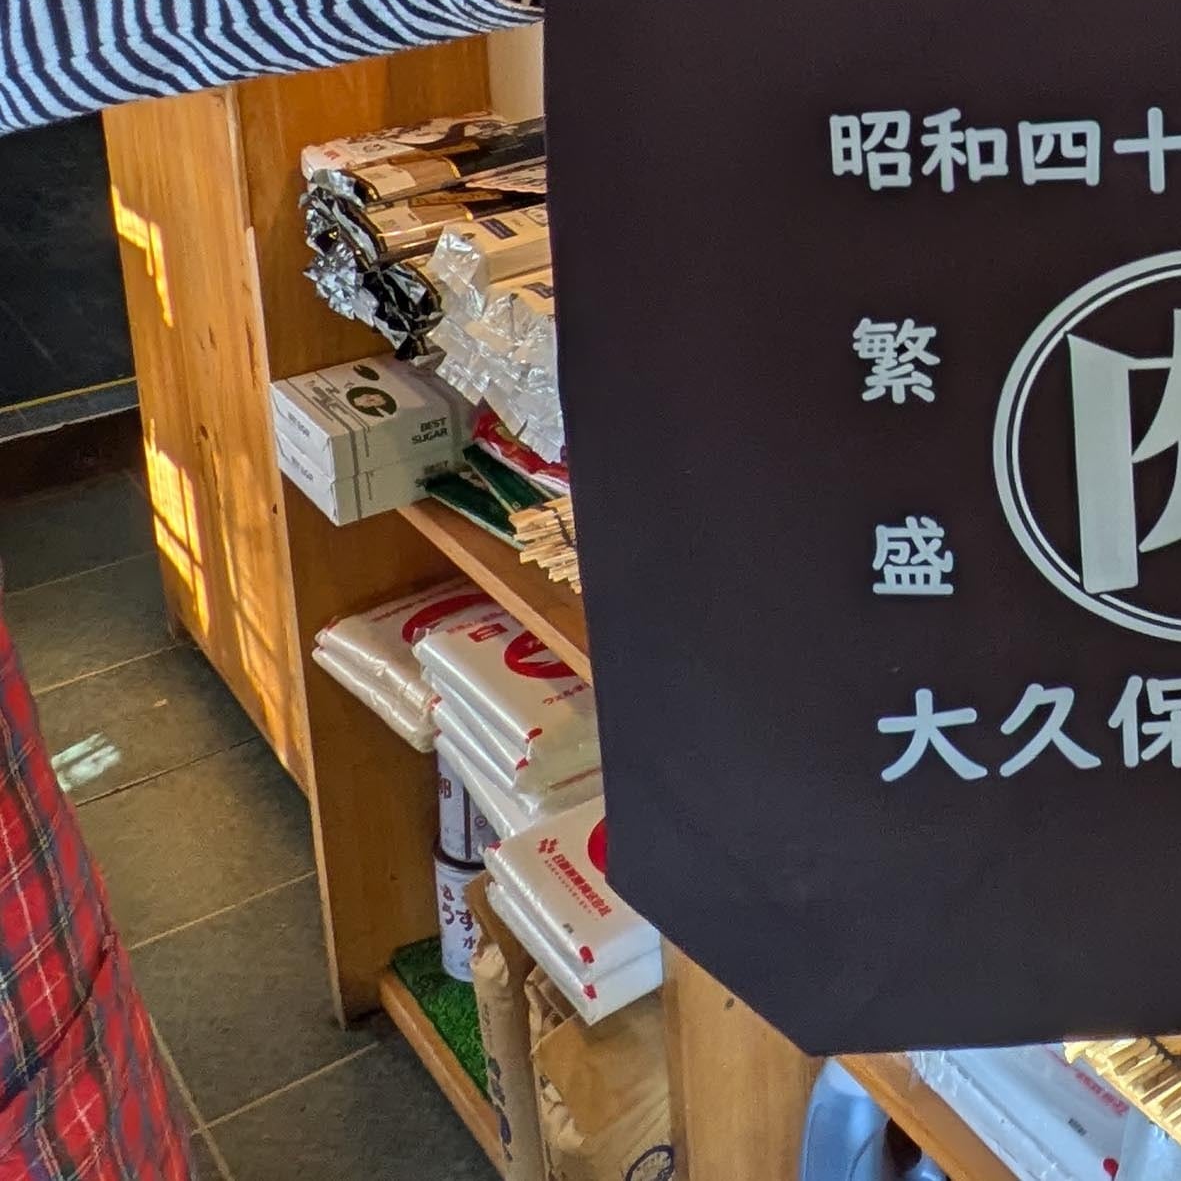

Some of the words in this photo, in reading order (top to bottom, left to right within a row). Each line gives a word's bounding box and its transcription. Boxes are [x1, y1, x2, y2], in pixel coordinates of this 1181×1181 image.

[420, 417, 447, 432] BEST
[411, 427, 449, 445] SUGAR
[853, 318, 953, 594] 繁盛
